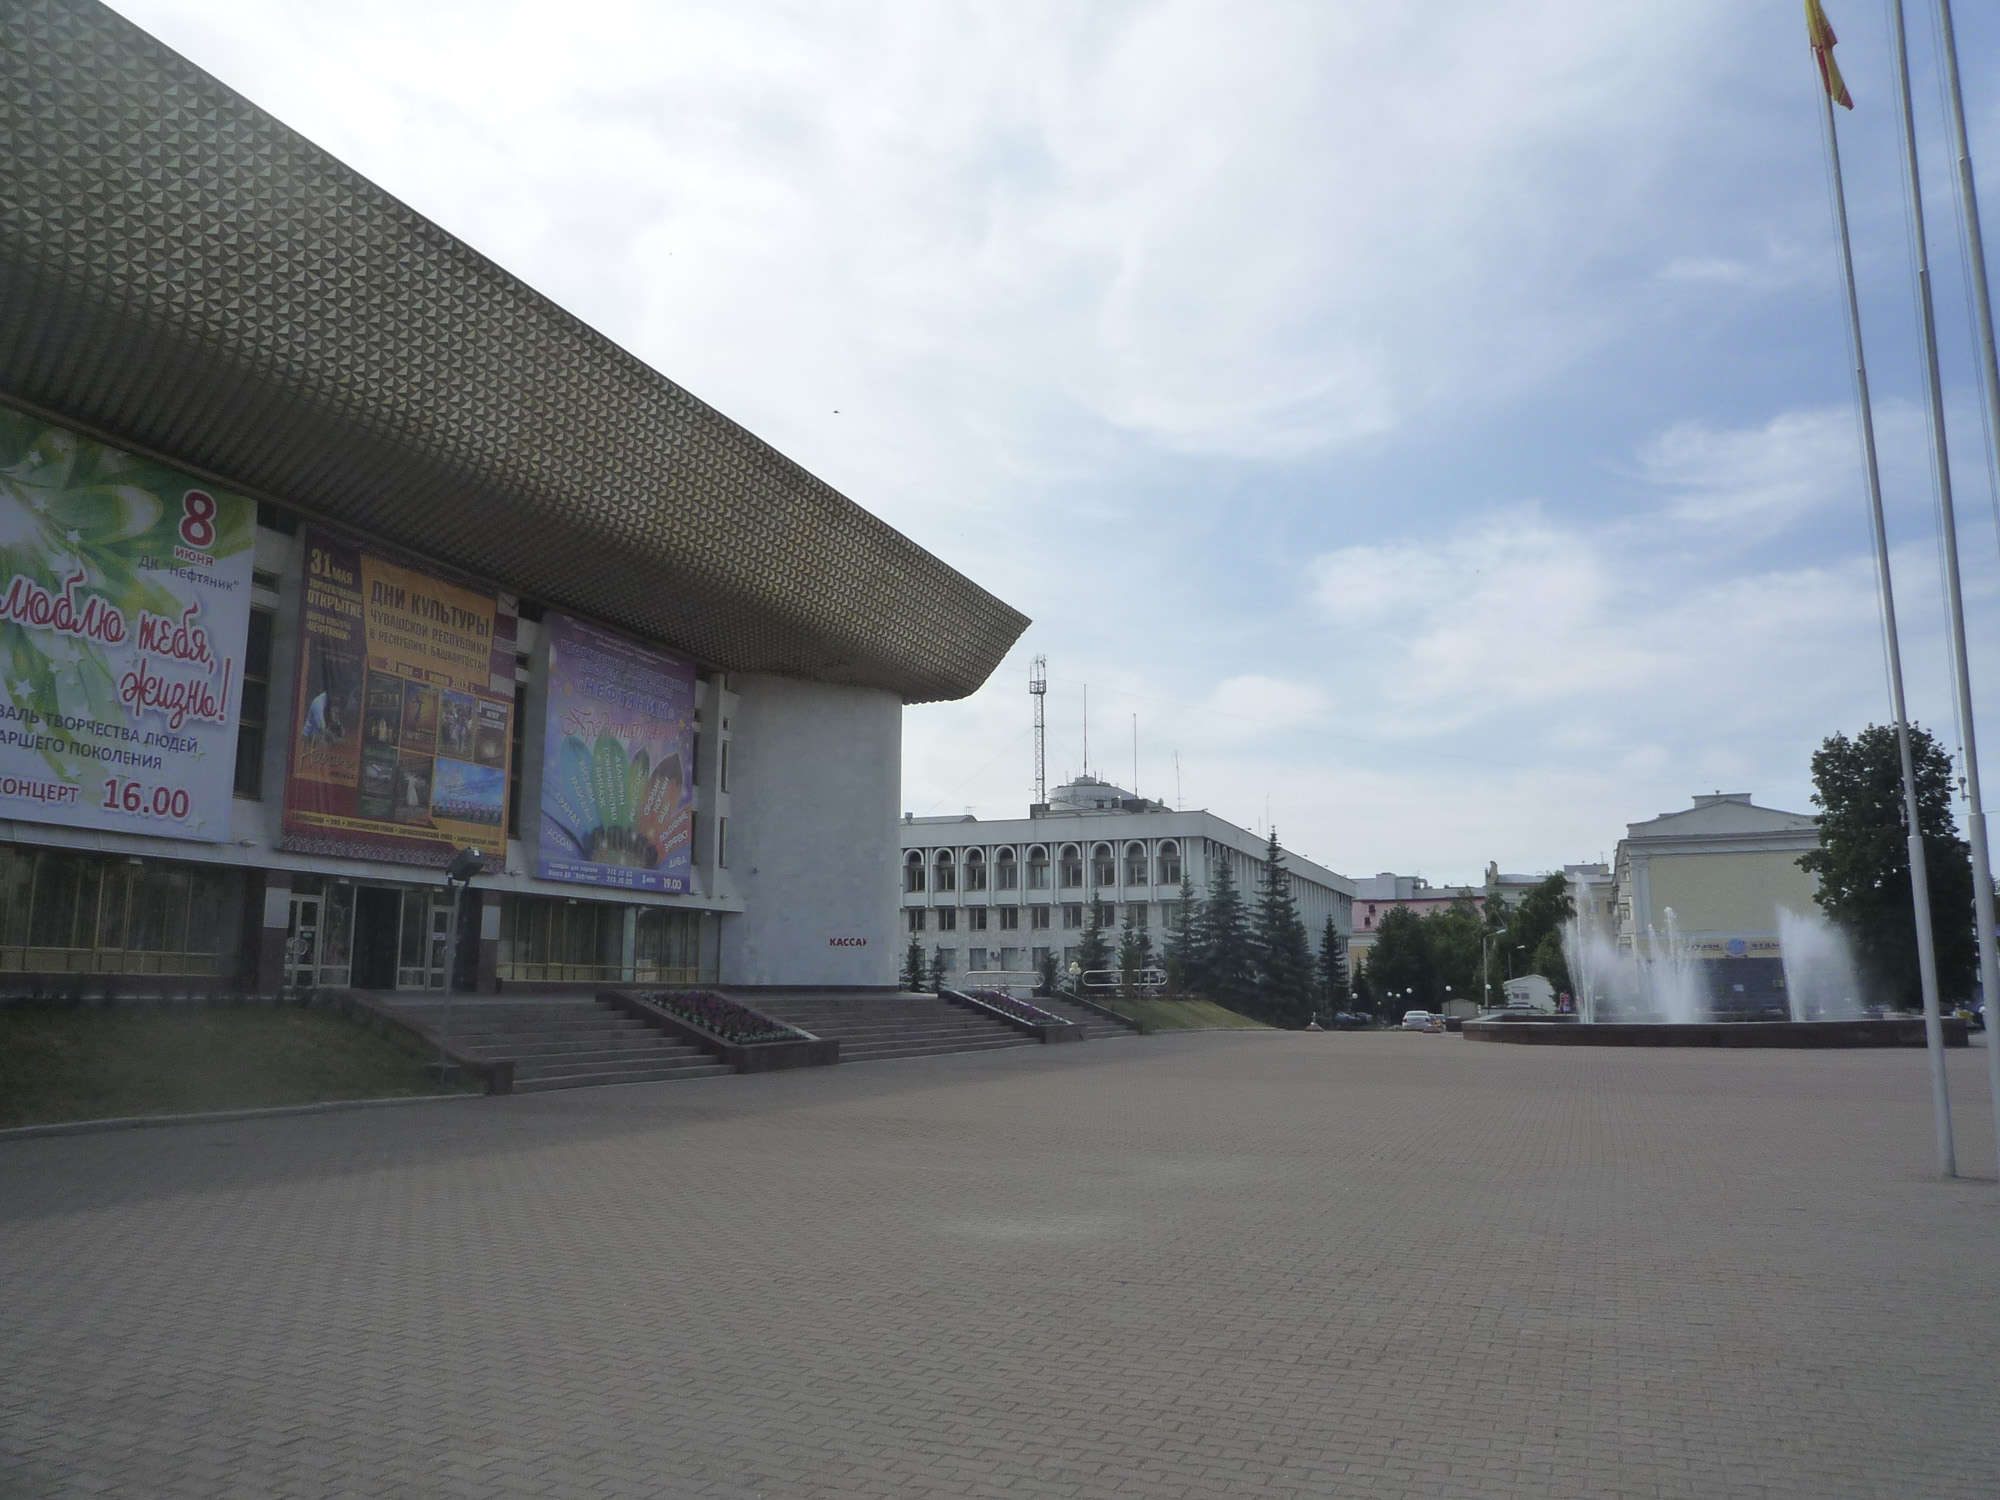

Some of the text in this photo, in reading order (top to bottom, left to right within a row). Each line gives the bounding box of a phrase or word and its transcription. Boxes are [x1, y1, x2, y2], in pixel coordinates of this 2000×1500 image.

[181, 491, 215, 547] 8
[138, 554, 159, 572] ДК
[174, 547, 214, 567] июня
[310, 548, 332, 578] 31
[307, 589, 363, 618] ОТКРЫТИЕ
[370, 579, 490, 638] ДНИ КУЛЬТУРЫ
[138, 602, 215, 674] тебя,
[369, 627, 488, 673] В РЕСПУБЛИКЕ БАШКОРТОСТАН
[370, 608, 489, 657] ЧУВАШСКОЙ РЕСПУБЛИКИ
[119, 657, 232, 730] жизнь!
[576, 677, 676, 721] «НЕФТЯНИК»
[46, 712, 141, 743] ТВОРЧЕСТВА
[143, 731, 198, 754] ЛЮДЕЙ
[69, 740, 162, 770] ПОКОЛЕНИЯ
[0, 777, 190, 819] ОНЦЕРТ 16.00
[595, 766, 607, 809] ВИРАЖ
[553, 792, 582, 827] ГРАНДЕ
[659, 810, 689, 844] ПОКОЛЕНИЕ
[546, 828, 574, 852] АССОЛЬ
[662, 877, 683, 891] 19.00
[829, 937, 862, 947] КАССА
